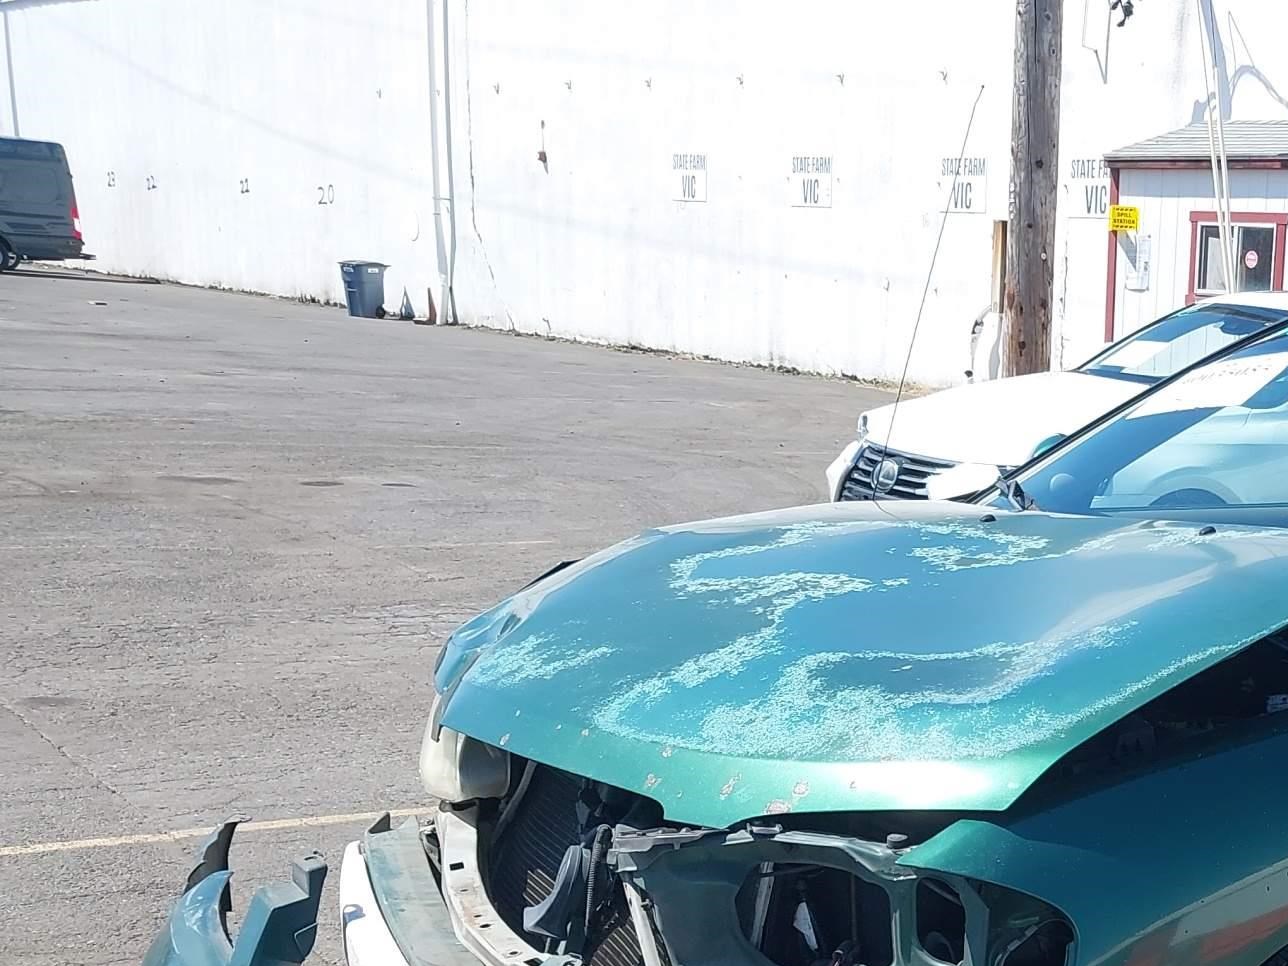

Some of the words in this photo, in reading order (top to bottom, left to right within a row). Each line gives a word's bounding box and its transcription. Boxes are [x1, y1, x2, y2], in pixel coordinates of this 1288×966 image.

[672, 154, 688, 170] STATE
[689, 154, 706, 171] FARM
[792, 156, 811, 173] STATE
[811, 157, 831, 173] FARM
[941, 158, 962, 176] STATE
[963, 158, 986, 176] FARM
[1071, 159, 1096, 178] STATE
[317, 184, 335, 205] 20
[682, 175, 696, 199] VIC
[802, 178, 819, 204] VIC
[952, 182, 972, 209] VIC
[1085, 185, 1107, 214] VIC
